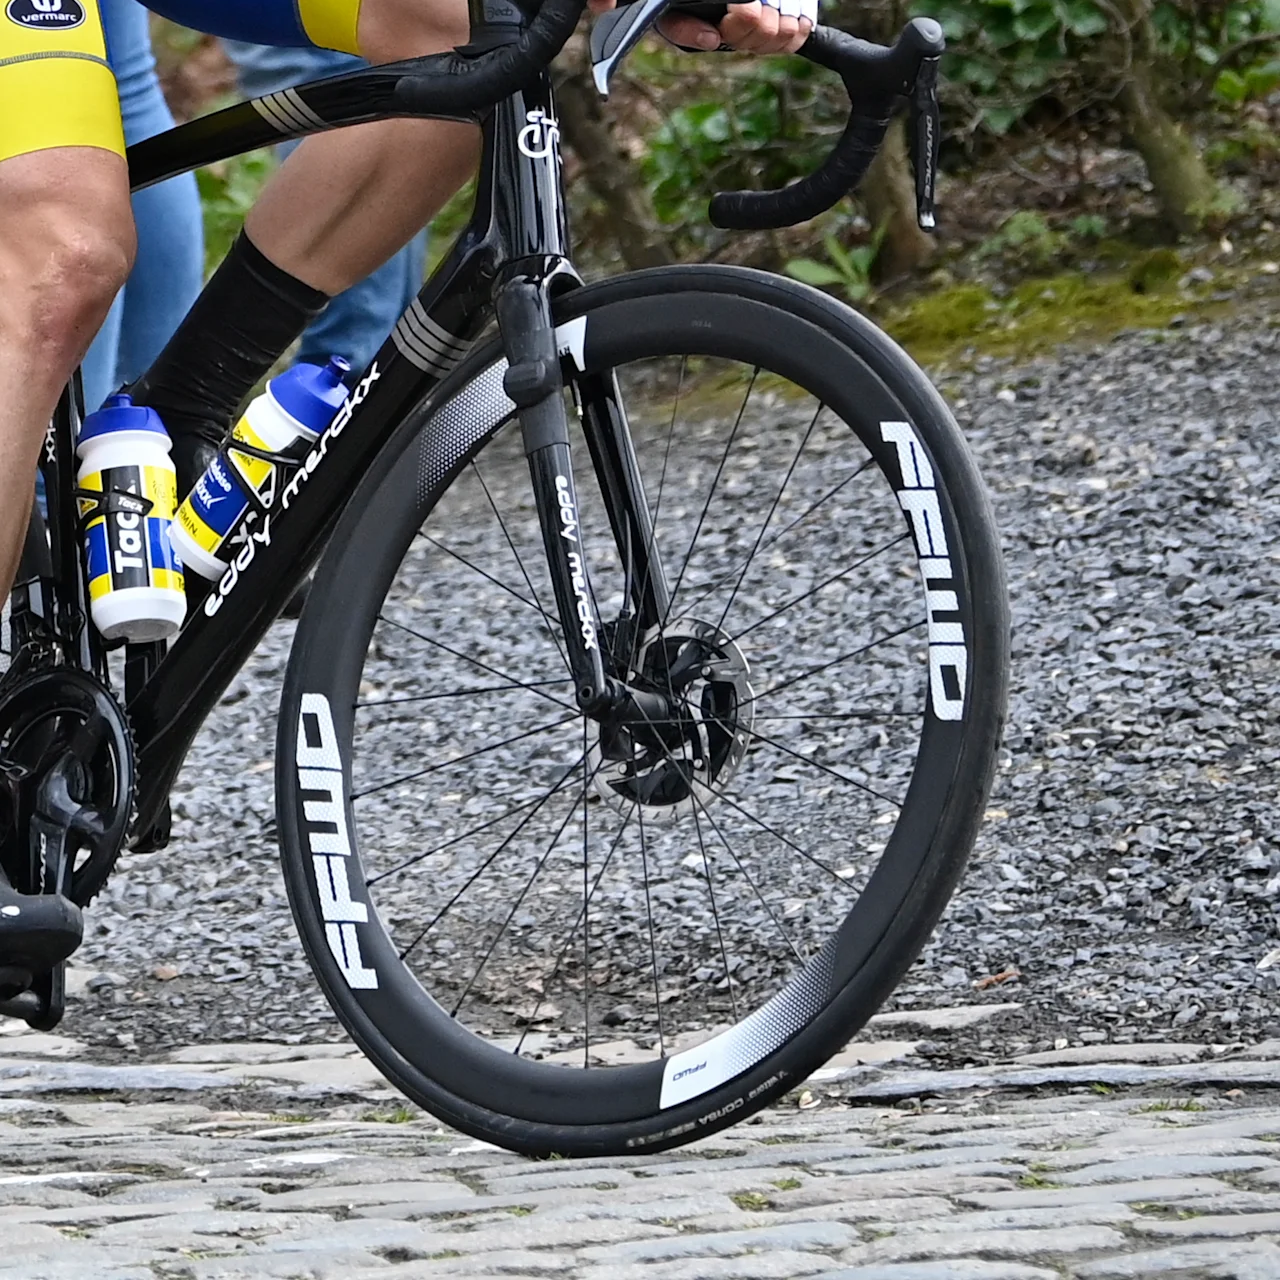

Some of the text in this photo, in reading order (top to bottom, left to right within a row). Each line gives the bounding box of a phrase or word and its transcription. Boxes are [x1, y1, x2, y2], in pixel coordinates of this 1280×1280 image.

[21, 12, 78, 23] vermarc
[280, 361, 382, 511] merckx
[114, 484, 144, 574] Tac
[117, 496, 144, 513] Tacx
[204, 511, 272, 618] eddy
[555, 474, 597, 651] eddy merckx
[879, 421, 969, 721] FFWD
[295, 692, 379, 990] FFWD
[672, 1060, 708, 1082] FFWD
